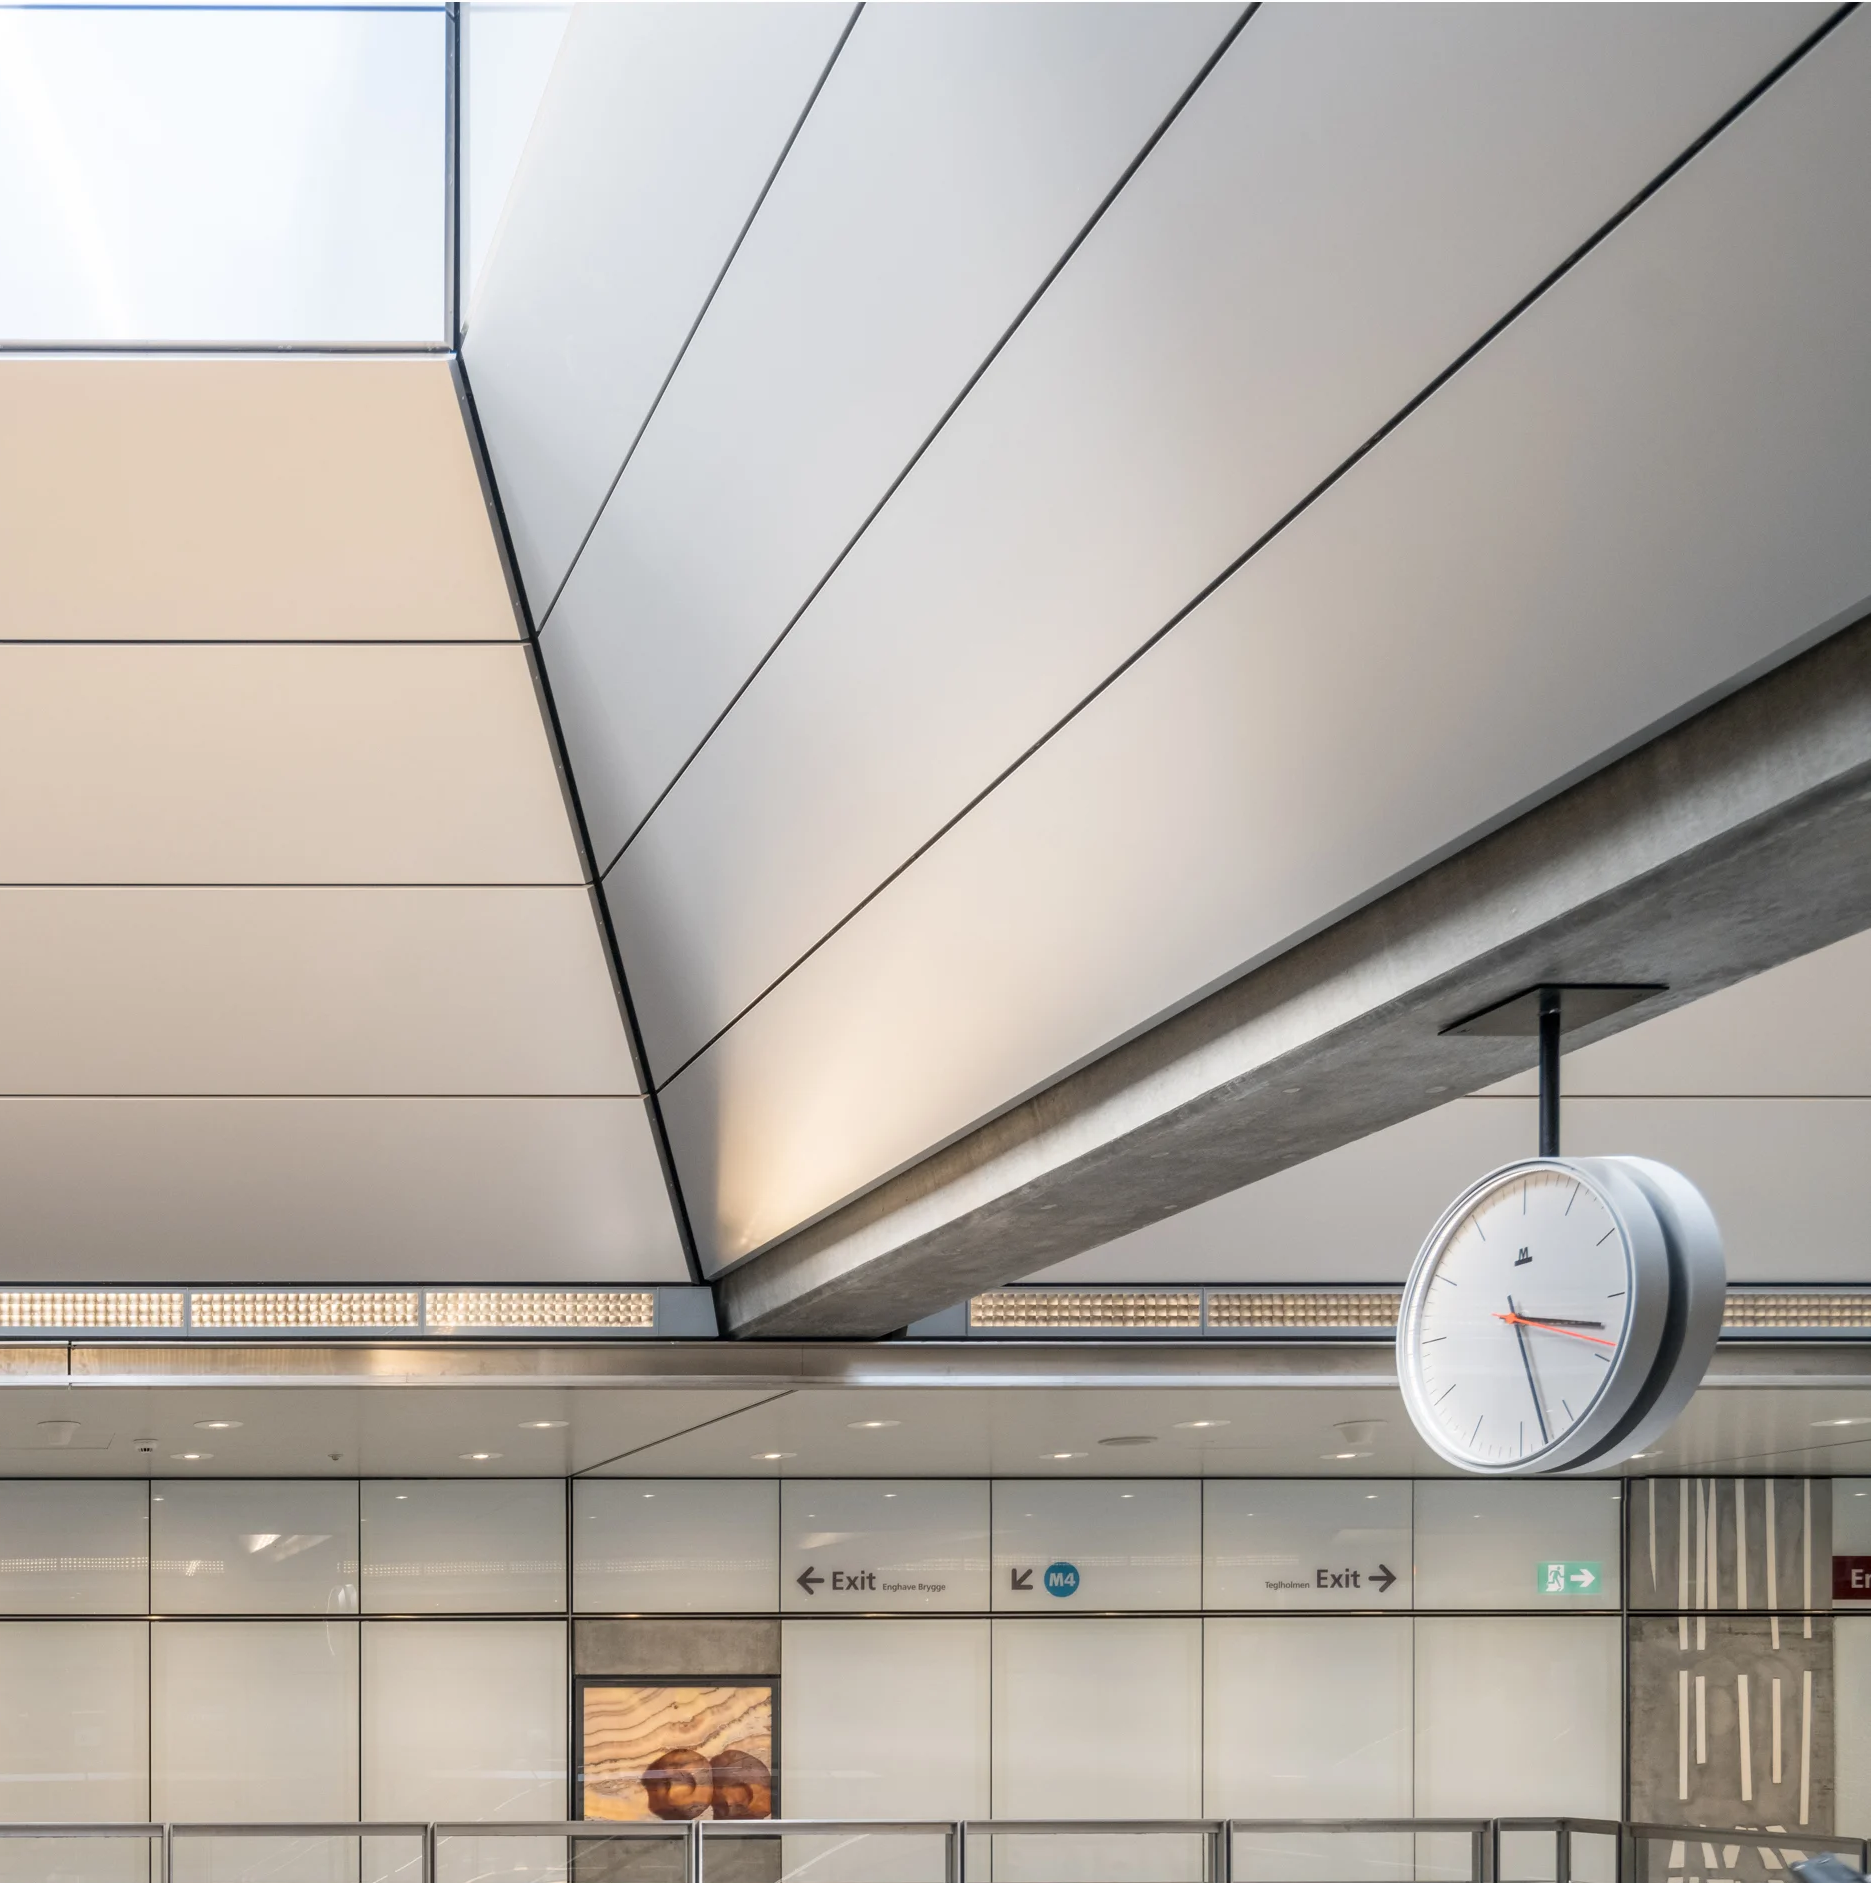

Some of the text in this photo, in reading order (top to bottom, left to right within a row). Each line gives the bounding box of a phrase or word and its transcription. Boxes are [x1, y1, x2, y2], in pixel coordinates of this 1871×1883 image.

[832, 1570, 946, 1593] Exit Enghave Brygge
[1049, 1572, 1076, 1587] M4
[1265, 1568, 1361, 1591] Teglholmen Exit
